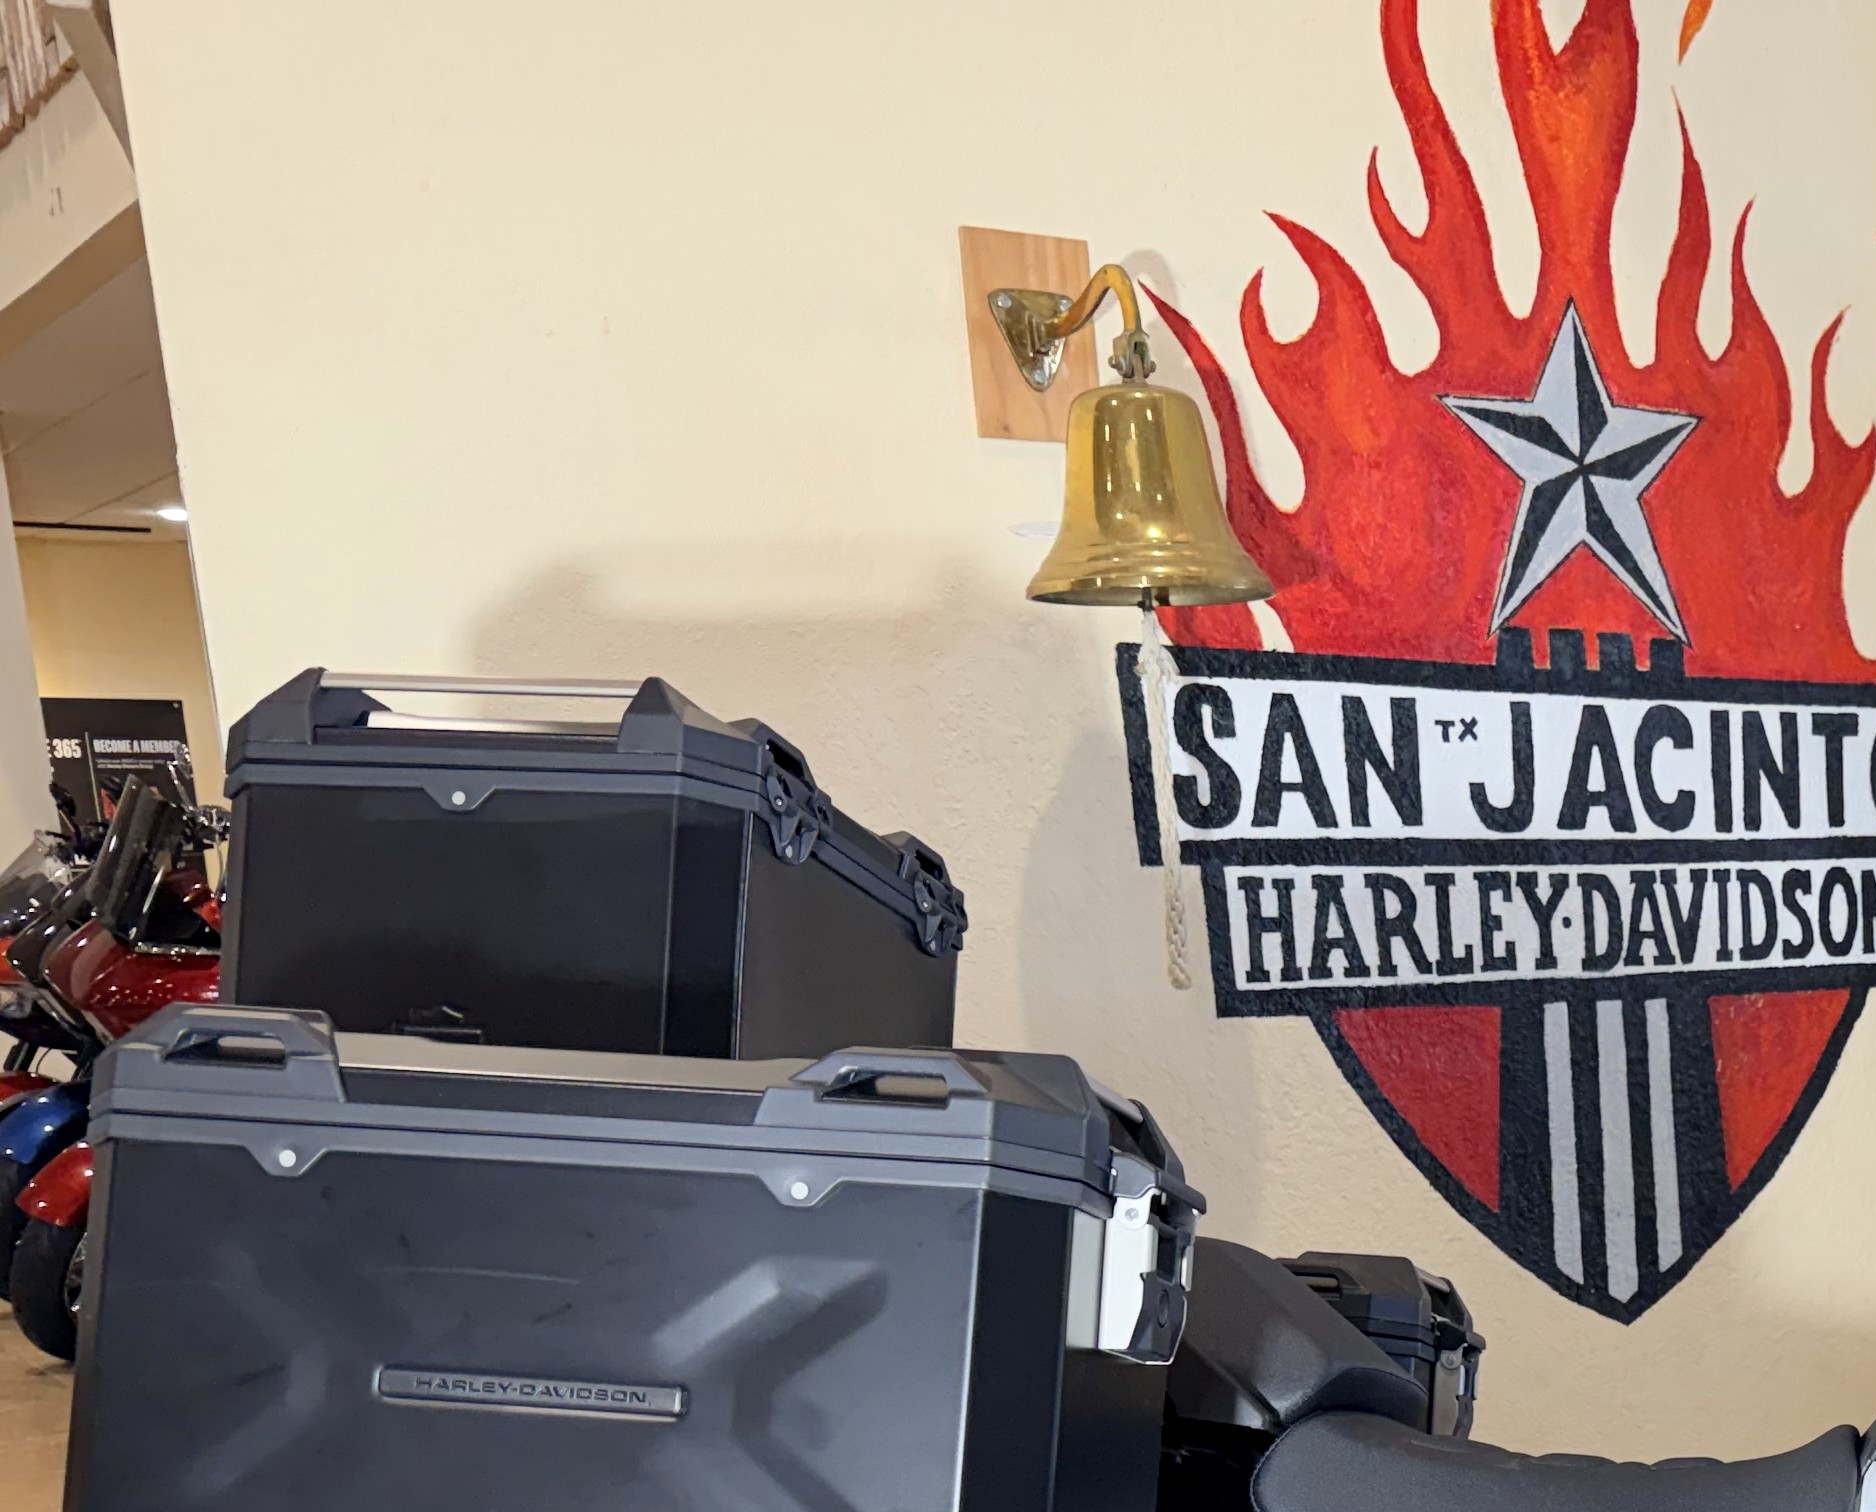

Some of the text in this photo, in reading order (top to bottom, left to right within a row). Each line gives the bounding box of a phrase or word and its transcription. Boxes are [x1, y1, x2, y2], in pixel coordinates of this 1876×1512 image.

[52, 738, 82, 759] 365
[93, 739, 133, 754] BECOME
[132, 740, 141, 754] A
[1172, 681, 1424, 830] SAN
[1434, 717, 1479, 744] TX
[414, 1375, 648, 1405] HARLEY-DAVIDSON
